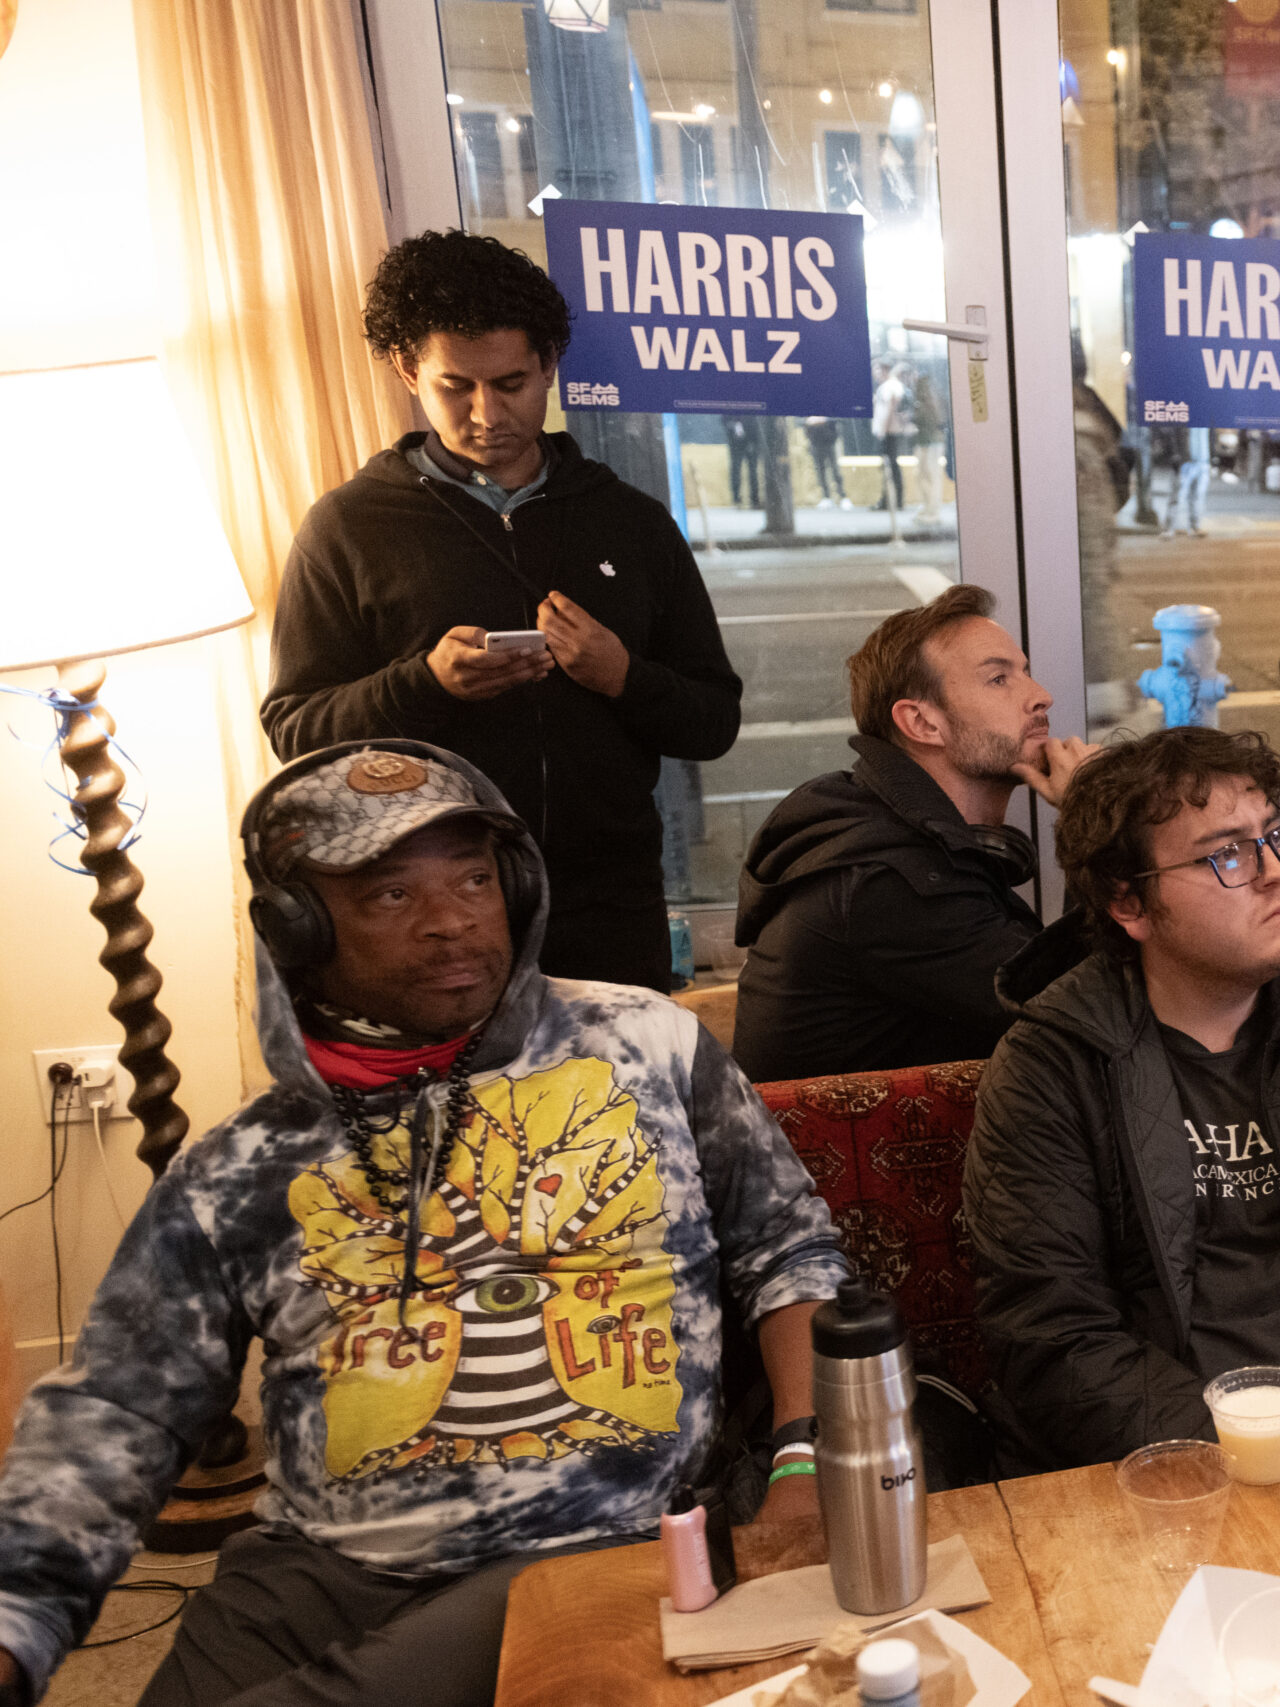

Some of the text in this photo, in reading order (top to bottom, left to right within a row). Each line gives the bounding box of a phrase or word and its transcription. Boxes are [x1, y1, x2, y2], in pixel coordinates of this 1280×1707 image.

[579, 226, 838, 322] HARRIS
[630, 325, 803, 375] WALZ
[567, 382, 591, 395] SF
[567, 393, 621, 407] DEMS
[1144, 400, 1165, 412] SF
[1144, 411, 1189, 423] DEMS
[574, 1270, 620, 1308] of
[330, 1311, 447, 1377] Tree
[555, 1303, 671, 1390] Life
